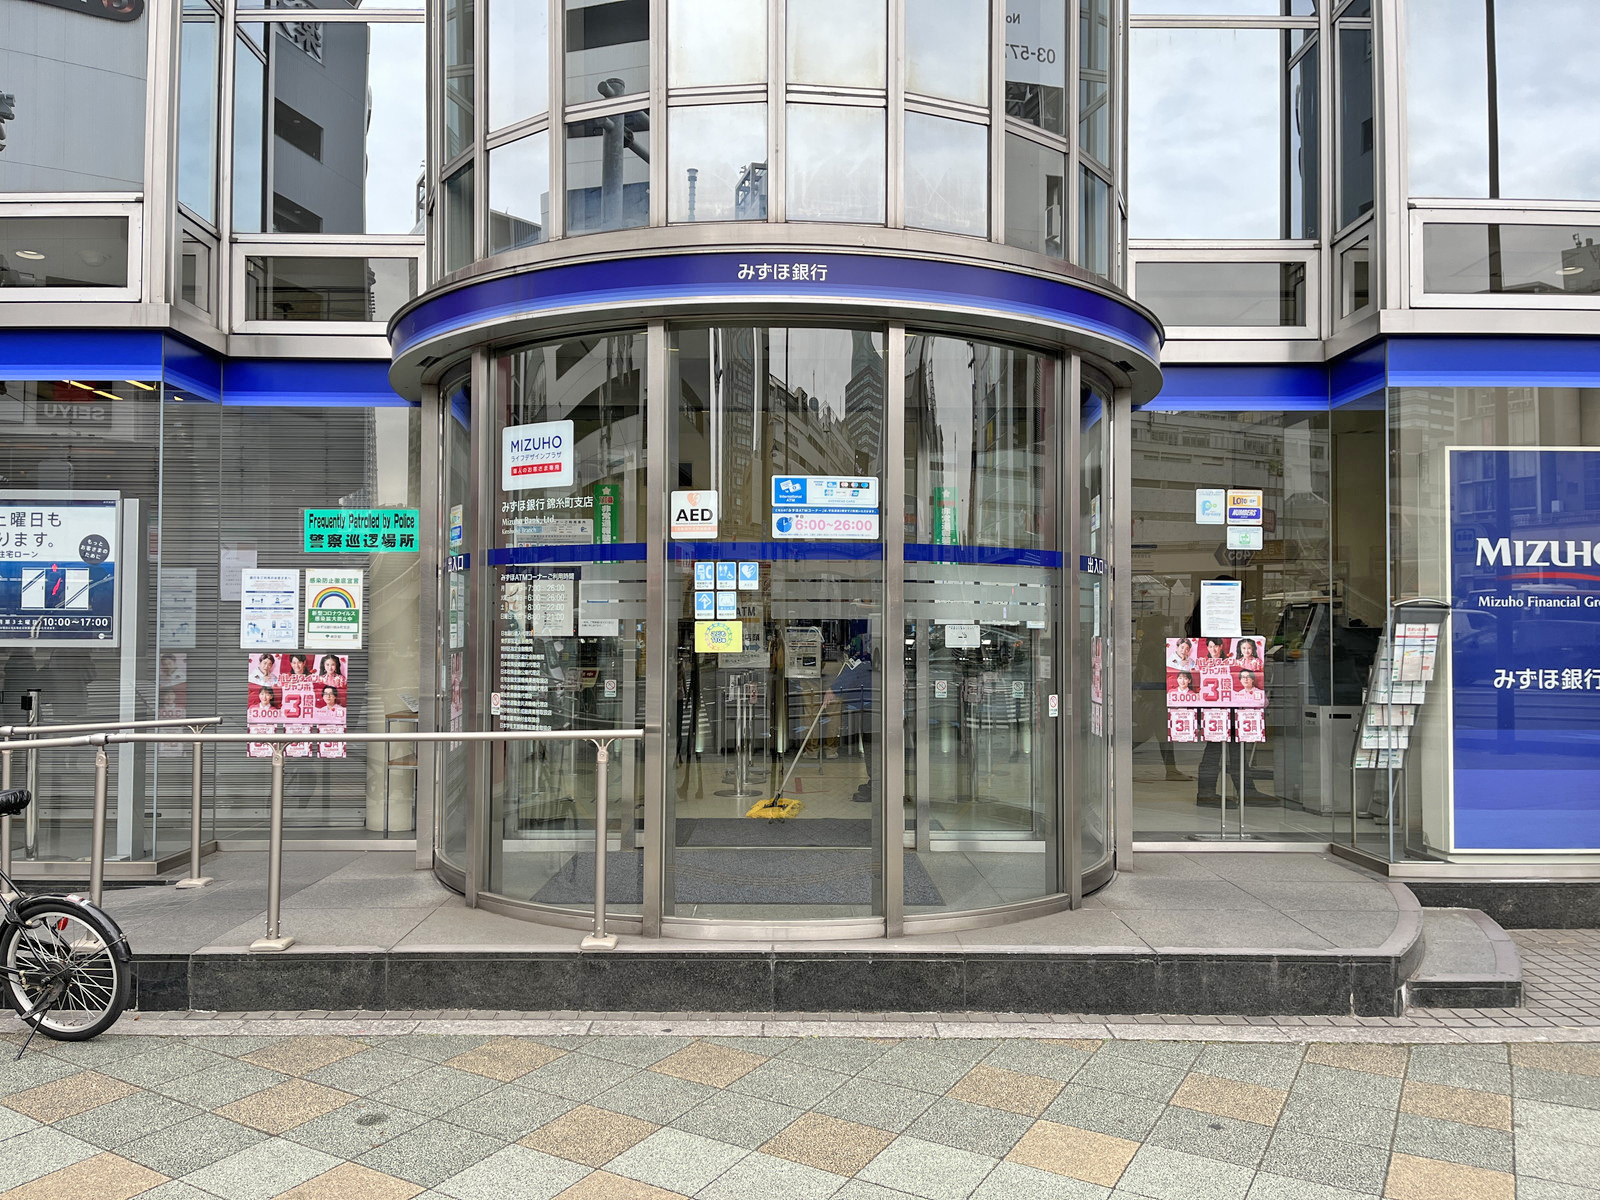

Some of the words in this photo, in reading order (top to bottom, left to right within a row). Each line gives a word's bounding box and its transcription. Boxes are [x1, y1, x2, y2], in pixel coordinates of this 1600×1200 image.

[738, 263, 828, 281] みずほ銀行
[510, 435, 562, 453] MIZUHO
[501, 498, 545, 512] みずほ銀行
[546, 496, 594, 510] 錦糸町支店
[309, 513, 346, 529] Frequently
[349, 513, 380, 528] Patrolled
[382, 513, 391, 529] by
[394, 513, 415, 528] Police
[675, 508, 714, 522] AED
[1475, 537, 1600, 566] MIZUH
[1087, 556, 1104, 574] 出入口
[1478, 596, 1524, 607] Mizuho
[1527, 596, 1581, 607] Financial
[1584, 596, 1600, 607] Gr
[1493, 668, 1600, 690] みずほ銀行
